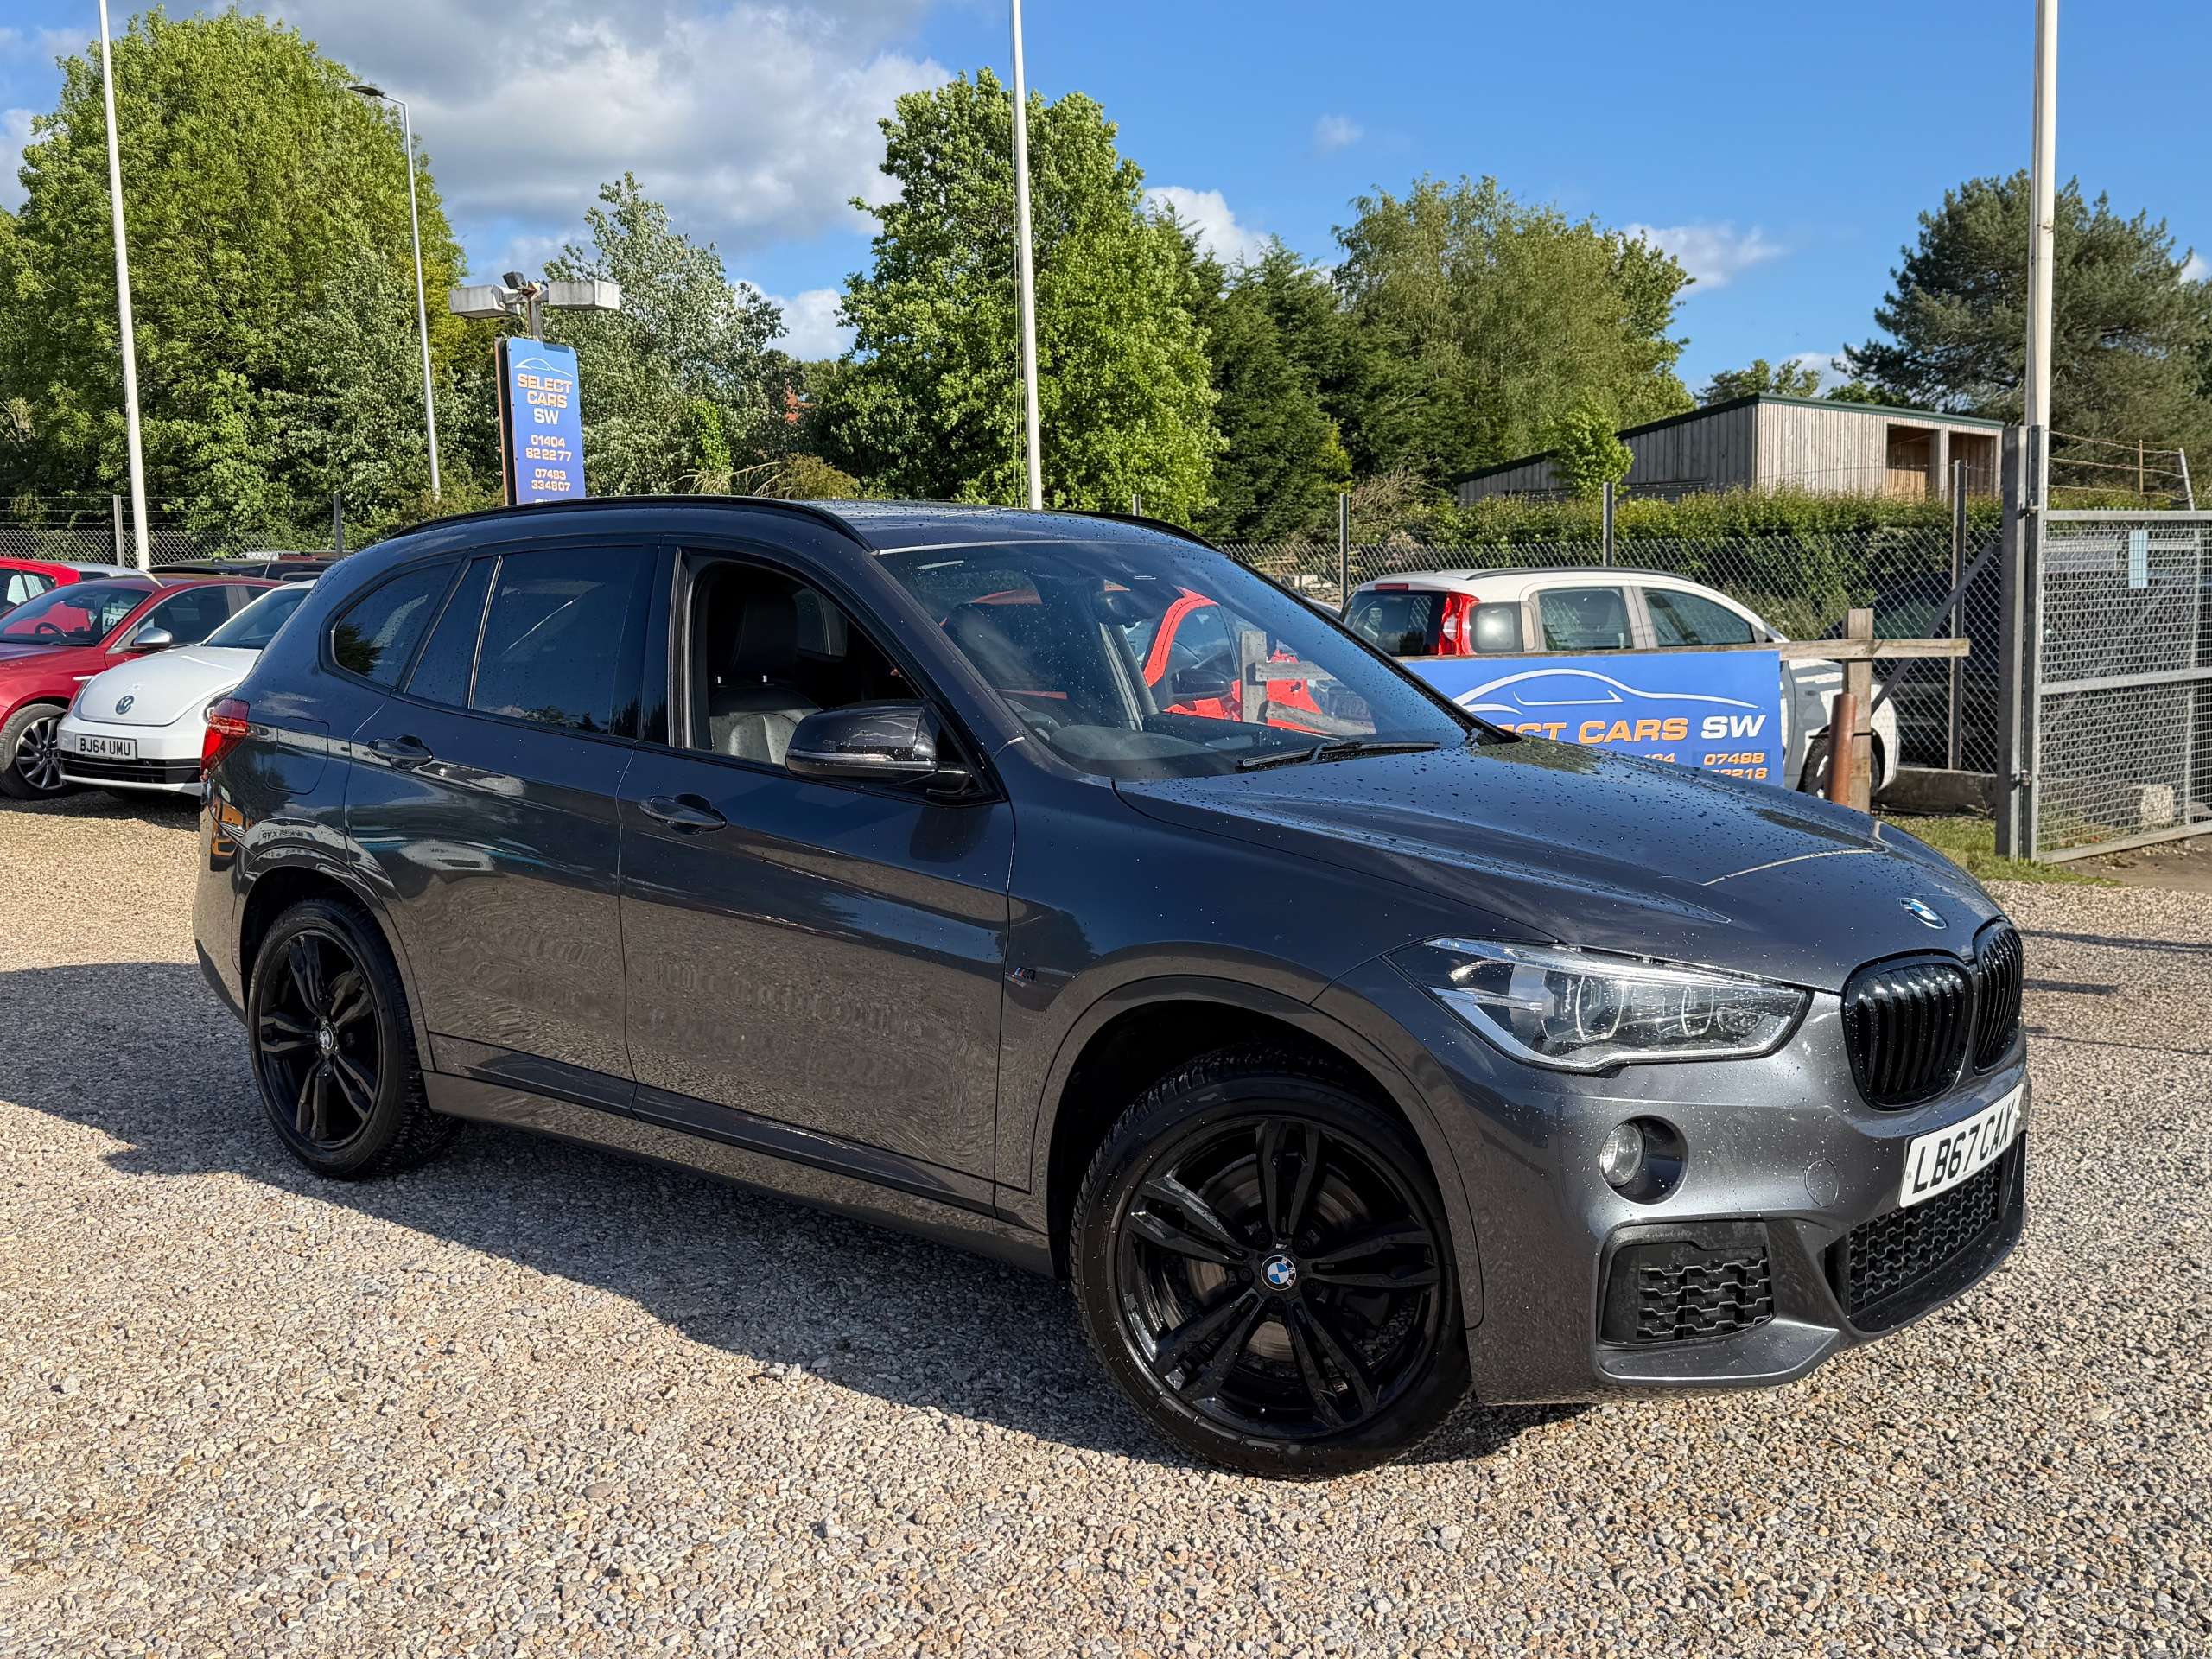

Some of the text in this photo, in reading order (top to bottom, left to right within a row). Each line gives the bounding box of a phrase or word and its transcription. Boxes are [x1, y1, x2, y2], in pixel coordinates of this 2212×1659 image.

[518, 373, 573, 394] SELECT
[527, 391, 568, 409] CARS
[534, 408, 559, 425] SW
[531, 434, 566, 448] 01404
[1578, 718, 1688, 745] CARS
[1700, 715, 1767, 740] SW
[79, 738, 131, 756] BJ64 UMU
[1703, 752, 1765, 766] 07498
[1912, 1098, 2017, 1194] LB67 CAX
